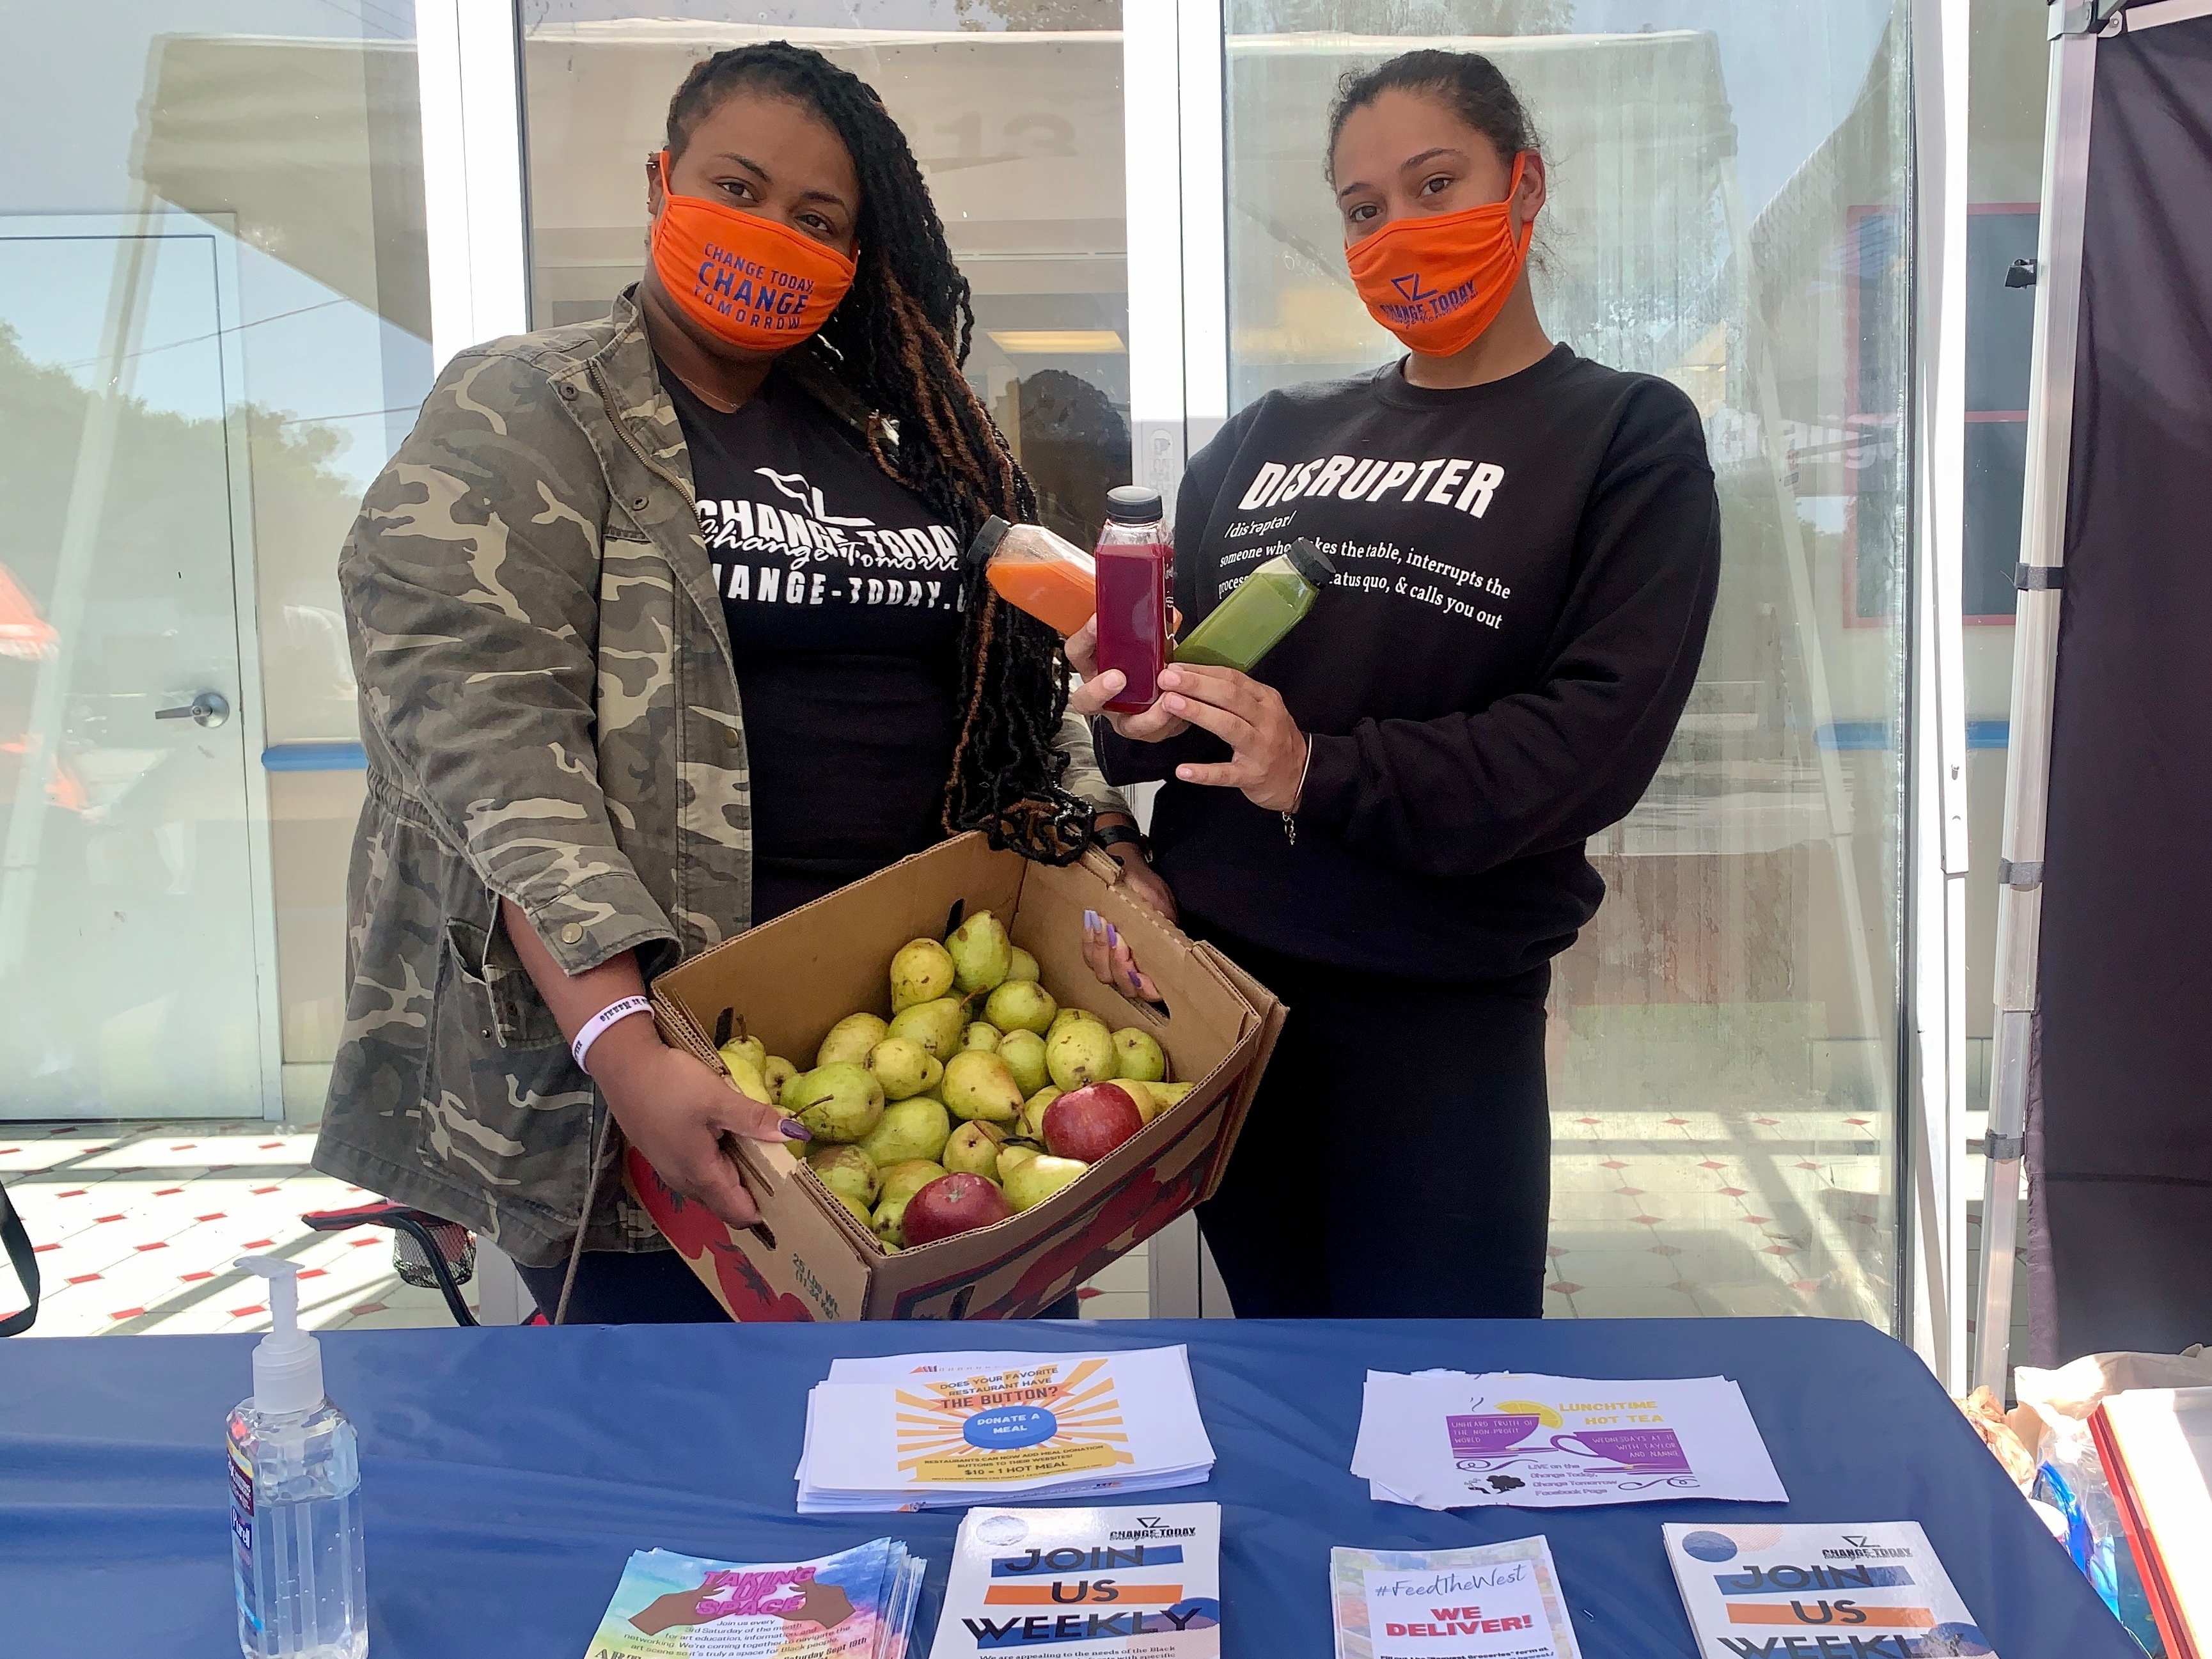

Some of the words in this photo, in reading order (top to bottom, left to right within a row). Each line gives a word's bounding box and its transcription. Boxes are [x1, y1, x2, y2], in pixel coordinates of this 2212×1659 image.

[705, 242, 765, 279] CHANGE
[771, 270, 815, 295] TODAY,
[698, 261, 809, 315] CHANGE
[1429, 279, 1475, 315] TODAY
[694, 285, 801, 330] TOMORROW
[1237, 455, 1506, 519] DISRUPTER
[695, 499, 849, 558] CHANGE
[1220, 546, 1262, 568] someone
[1266, 540, 1291, 556] who
[1340, 540, 1366, 558] the
[1365, 543, 1402, 564] table,
[1406, 547, 1484, 590] interrupts
[1486, 576, 1511, 600] the
[1362, 575, 1391, 594] quo,
[1395, 578, 1408, 594] &
[1409, 583, 1444, 606] calls
[1443, 595, 1475, 618] you
[1476, 608, 1503, 629] out
[940, 1380, 970, 1390] DOES
[973, 1375, 1003, 1385] YOUR
[1006, 1366, 1059, 1380] FAVORITE
[949, 1381, 1019, 1397] RESTAURANT
[1023, 1376, 1052, 1387] HAVE
[941, 1396, 973, 1409] THE
[980, 1385, 1059, 1406] BUTTON?
[1558, 1401, 1658, 1411] LUNCHTIME
[977, 1413, 1027, 1426] DONATE
[1031, 1412, 1041, 1420] A
[993, 1424, 1028, 1435] MEAL
[1584, 1416, 1619, 1425] HOT
[1626, 1415, 1664, 1423] TEA
[1063, 1445, 1104, 1454] DONATION
[1592, 1435, 1647, 1443] WEDNESDAYS
[1035, 1461, 1069, 1470] MEAL
[1110, 1529, 1156, 1539] CHANGE
[1159, 1527, 1196, 1536] TODAY
[1005, 1544, 1144, 1572] JOIN
[1822, 1548, 1869, 1558] CHANGE
[1872, 1547, 1912, 1558] TODAY
[704, 1566, 817, 1588] TAKING
[1374, 1564, 1527, 1597] #FeedTheWest
[1729, 1564, 1874, 1590] JOIN
[732, 1585, 778, 1601] UP
[1051, 1578, 1119, 1604] US
[696, 1594, 807, 1616] SPACE
[1430, 1605, 1483, 1621] WE
[1790, 1599, 1867, 1624] US
[695, 1633, 742, 1642] education,
[799, 1626, 817, 1635] and
[702, 1627, 741, 1635] Saturday
[773, 1622, 802, 1631] month
[961, 1606, 1202, 1641] WEEKLY
[1385, 1614, 1535, 1637] DELIVER!
[707, 1642, 741, 1650] coming
[742, 1640, 785, 1650] together
[796, 1631, 835, 1644] navigate
[781, 1644, 805, 1653] Black
[826, 1644, 847, 1655] Sept
[1716, 1634, 1964, 1659] WEEKLY
